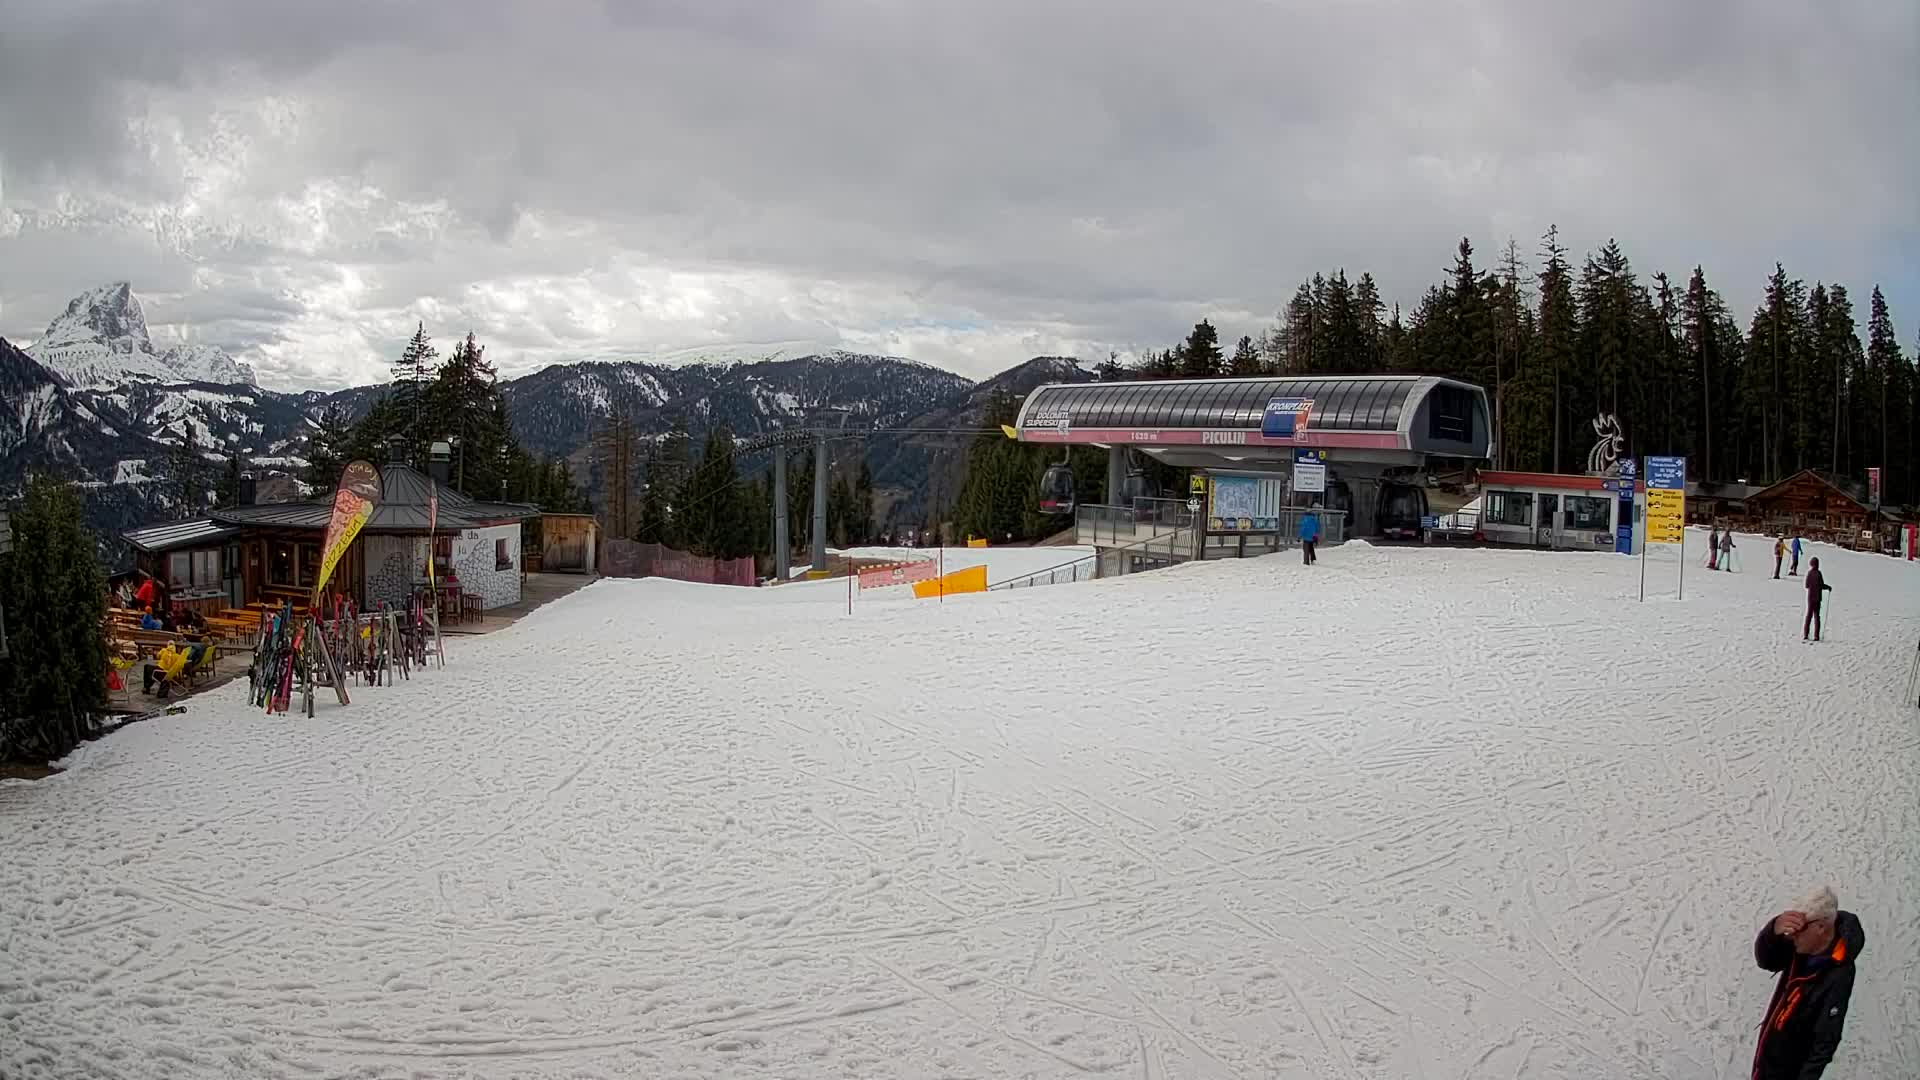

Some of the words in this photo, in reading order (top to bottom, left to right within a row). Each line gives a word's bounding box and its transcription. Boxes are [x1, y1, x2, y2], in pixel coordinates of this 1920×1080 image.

[1267, 402, 1312, 411] KRONPLATZ
[1026, 419, 1059, 427] SUPERSKI
[1202, 432, 1246, 444] PICULIN
[467, 531, 479, 540] da
[324, 518, 361, 571] PIZZERIA
